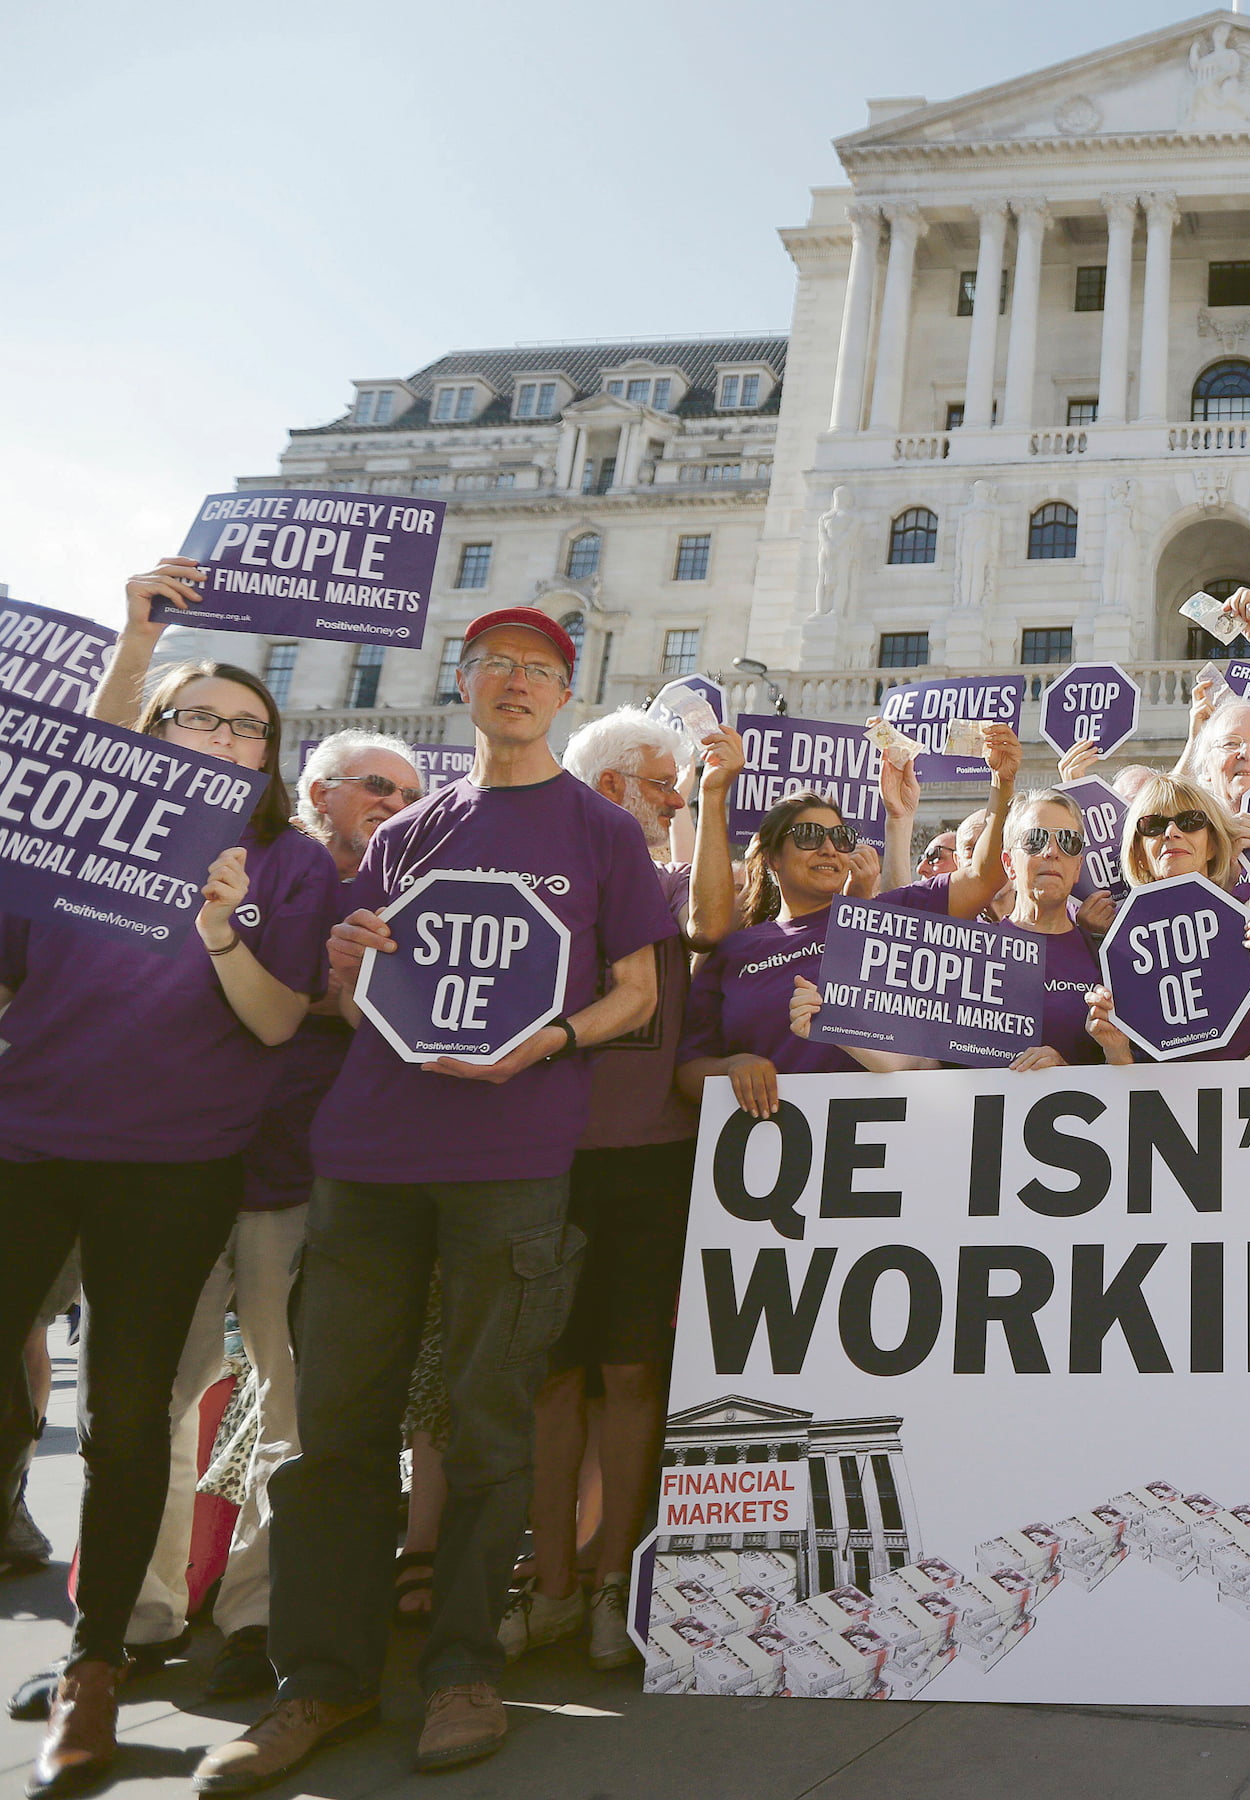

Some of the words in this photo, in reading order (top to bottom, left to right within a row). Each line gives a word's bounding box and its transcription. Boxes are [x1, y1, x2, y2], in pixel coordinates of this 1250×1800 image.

[201, 497, 292, 522] CREATE
[292, 498, 384, 529] MONEY
[386, 505, 436, 534] FOR
[210, 523, 391, 580] PEOPLE
[213, 568, 320, 602] FINANCIAL
[325, 581, 421, 613] MARKETS
[316, 618, 395, 637] PositiveMoney
[883, 690, 919, 721] QE
[921, 685, 1017, 719] DRIVES
[1063, 682, 1120, 712] STOP
[1074, 713, 1103, 742] QE
[72, 732, 192, 792] MONEY
[185, 767, 251, 813] FOR
[442, 752, 474, 772] FOR
[742, 728, 783, 771] QE
[790, 732, 881, 781] DRIVE
[77, 854, 198, 909] MARKETS
[1085, 846, 1122, 889] QE
[53, 897, 151, 936] PositiveMoney
[837, 904, 918, 941] CREATE
[923, 920, 997, 955] MONEY
[1000, 935, 1039, 964] FOR
[413, 911, 530, 970] STOP
[1129, 909, 1219, 975] STOP
[859, 938, 1006, 1006] PEOPLE
[1044, 979, 1094, 992] Money
[431, 974, 496, 1032] QE
[823, 982, 863, 1008] NOT
[863, 990, 952, 1024] FINANCIAL
[956, 1005, 1035, 1038] MARKETS
[1159, 968, 1208, 1025] QE
[416, 1041, 479, 1052] PositiveMoney
[822, 1025, 895, 1042] positivemoney.org.uk
[949, 1041, 1016, 1061] PositiveMoney
[1160, 1032, 1210, 1049] PositiveMoney
[713, 1097, 907, 1240] QE
[664, 1470, 795, 1496] FINANCIAL
[667, 1499, 789, 1526] MARKETS
